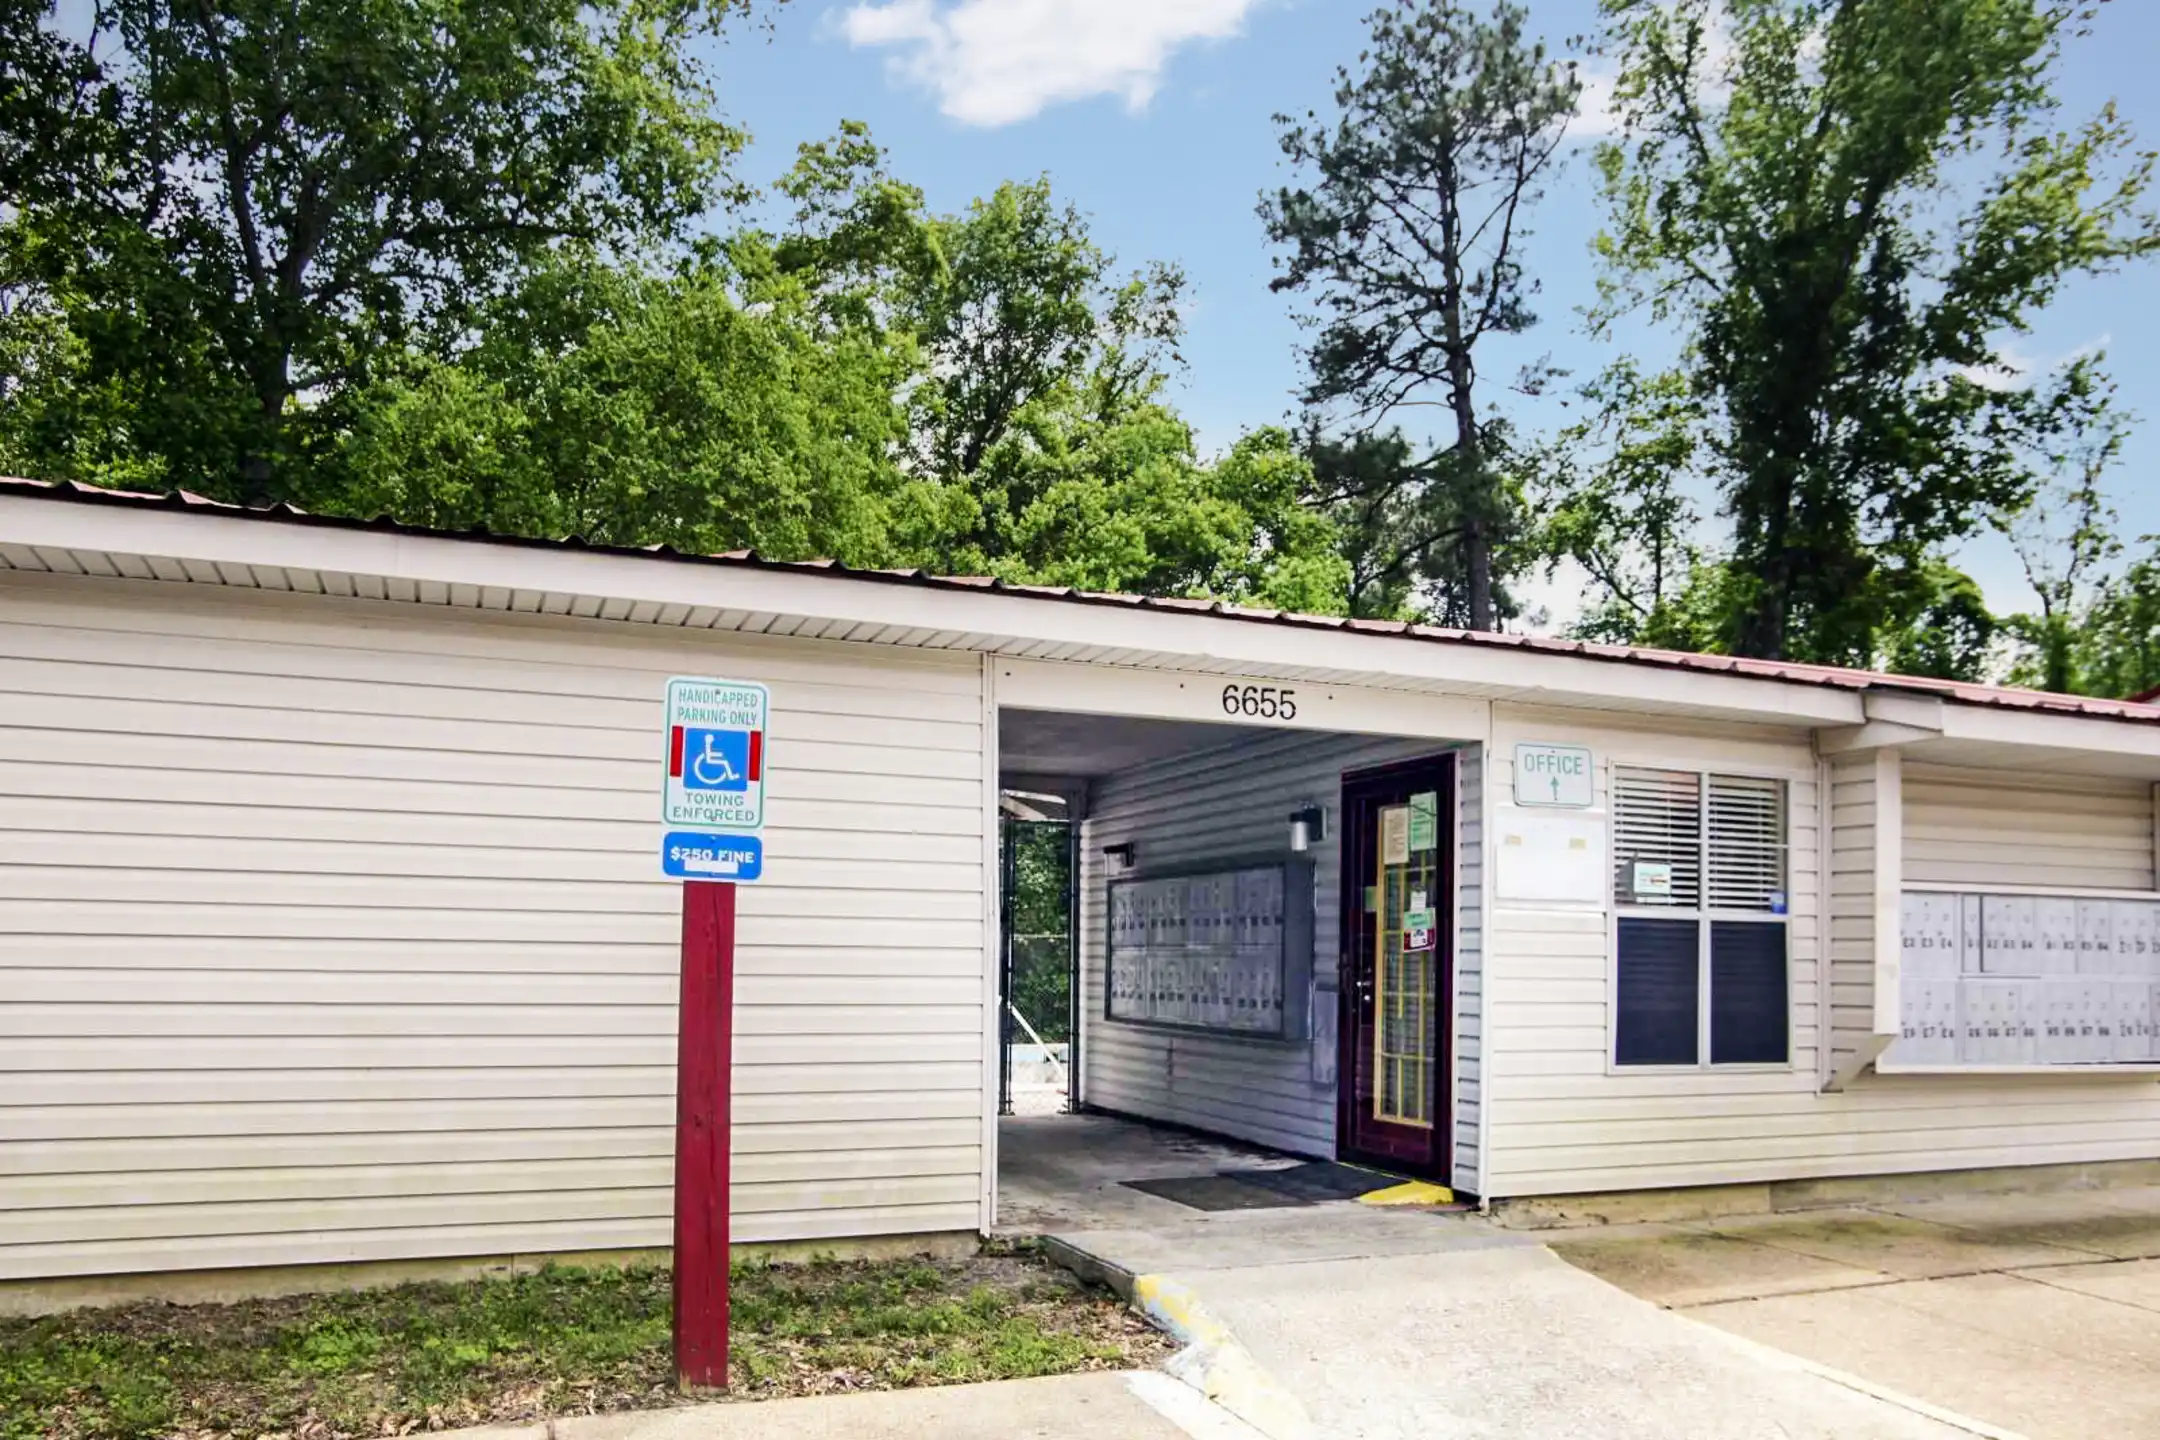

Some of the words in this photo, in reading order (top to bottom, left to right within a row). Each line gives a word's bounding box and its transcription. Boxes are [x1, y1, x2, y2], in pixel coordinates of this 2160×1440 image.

[678, 687, 758, 708] HANDICAPPED
[1222, 684, 1297, 720] 6655
[678, 706, 726, 724] PARKING
[730, 710, 757, 726] ONLY
[1524, 753, 1583, 776] OFFICE
[685, 792, 745, 807] TOWING
[673, 806, 755, 821] ENFORCED
[670, 845, 713, 862] $250
[717, 848, 755, 864] FINE
